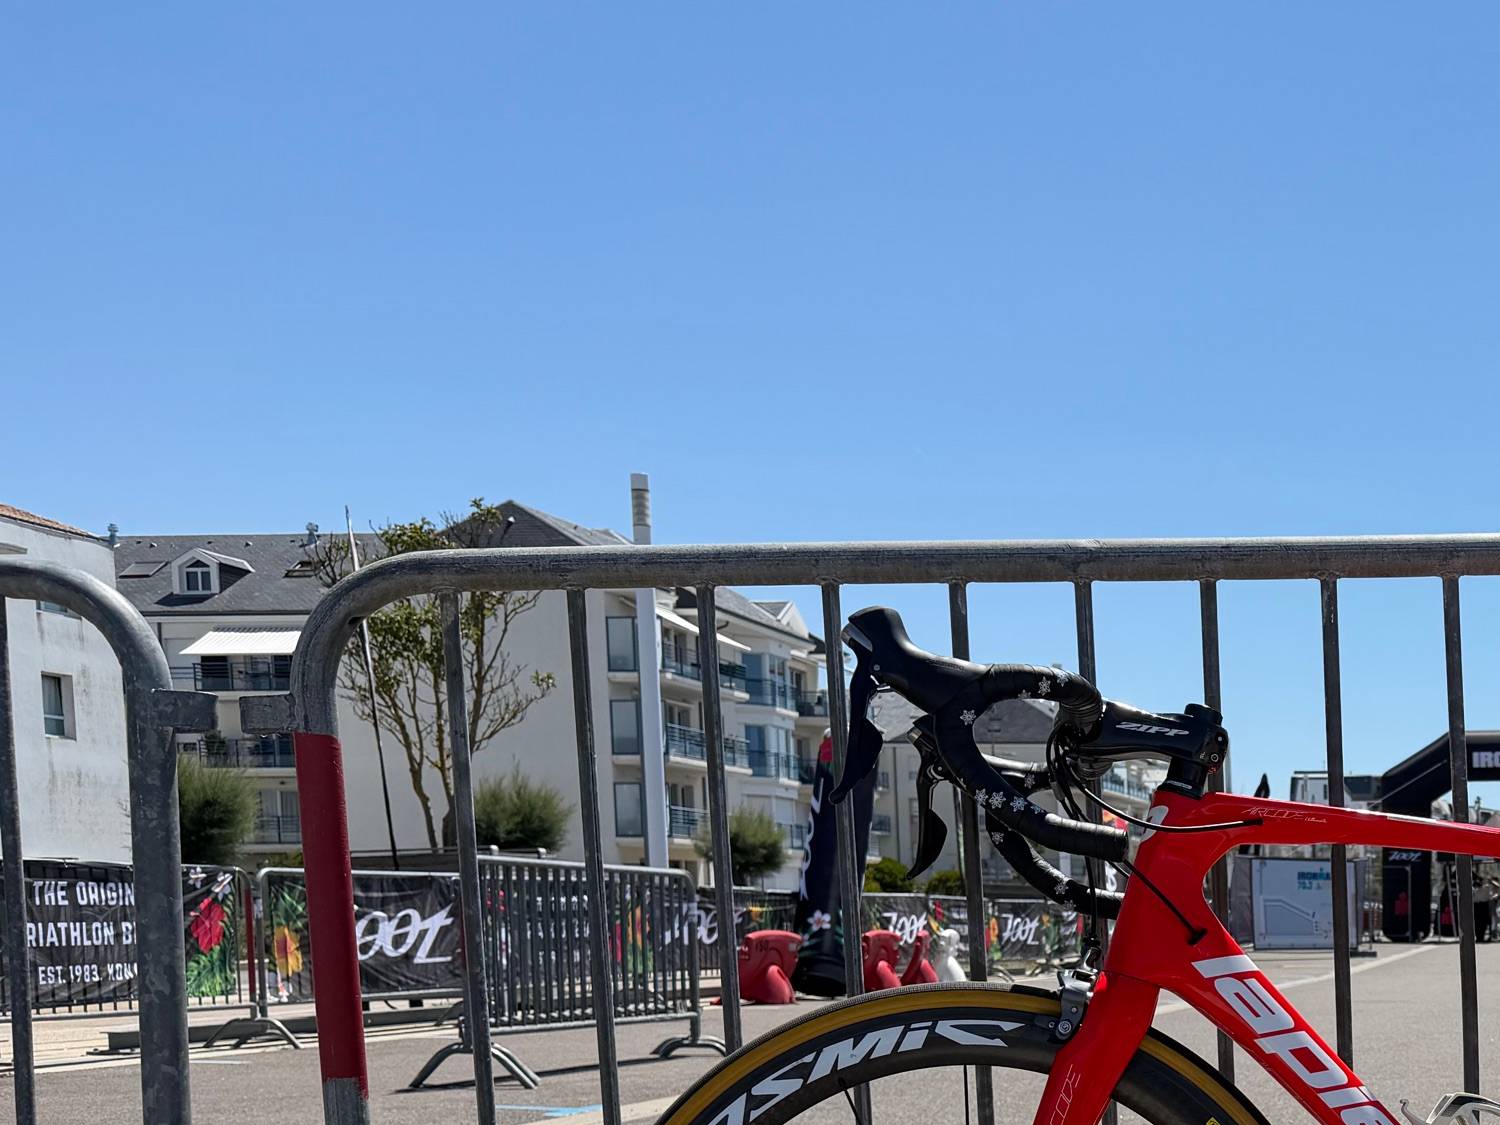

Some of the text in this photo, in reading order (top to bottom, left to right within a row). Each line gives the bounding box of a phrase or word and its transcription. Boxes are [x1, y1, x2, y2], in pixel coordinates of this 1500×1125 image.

[1115, 721, 1190, 737] ZIPP
[33, 880, 135, 907] THE ORIGIN
[27, 921, 114, 948] RIATHLON
[354, 903, 455, 964] oot
[38, 962, 138, 985] EST. 1983. KON
